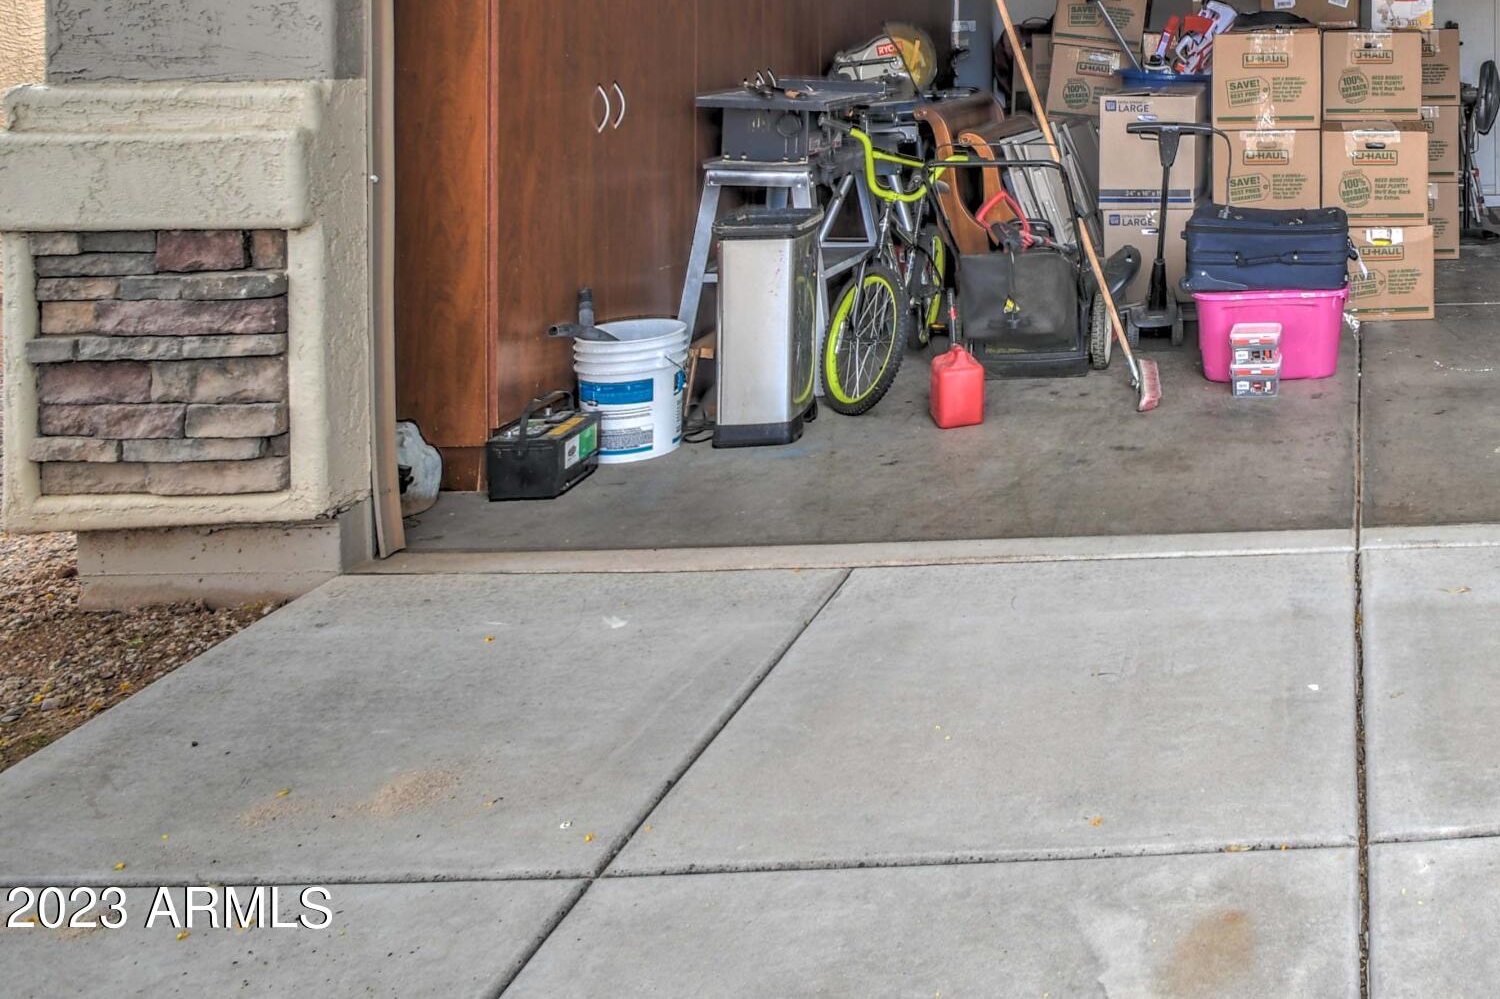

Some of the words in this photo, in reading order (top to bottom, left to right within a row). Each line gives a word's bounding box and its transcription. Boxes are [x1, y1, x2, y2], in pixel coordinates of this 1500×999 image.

[1229, 79, 1260, 90] SAVE!
[1343, 75, 1365, 86] 100%
[1067, 85, 1086, 93] 100%
[1118, 104, 1150, 112] LARGE
[1229, 176, 1260, 187] SAVE!
[1343, 178, 1367, 189] 100%
[1122, 218, 1153, 226] LARGE
